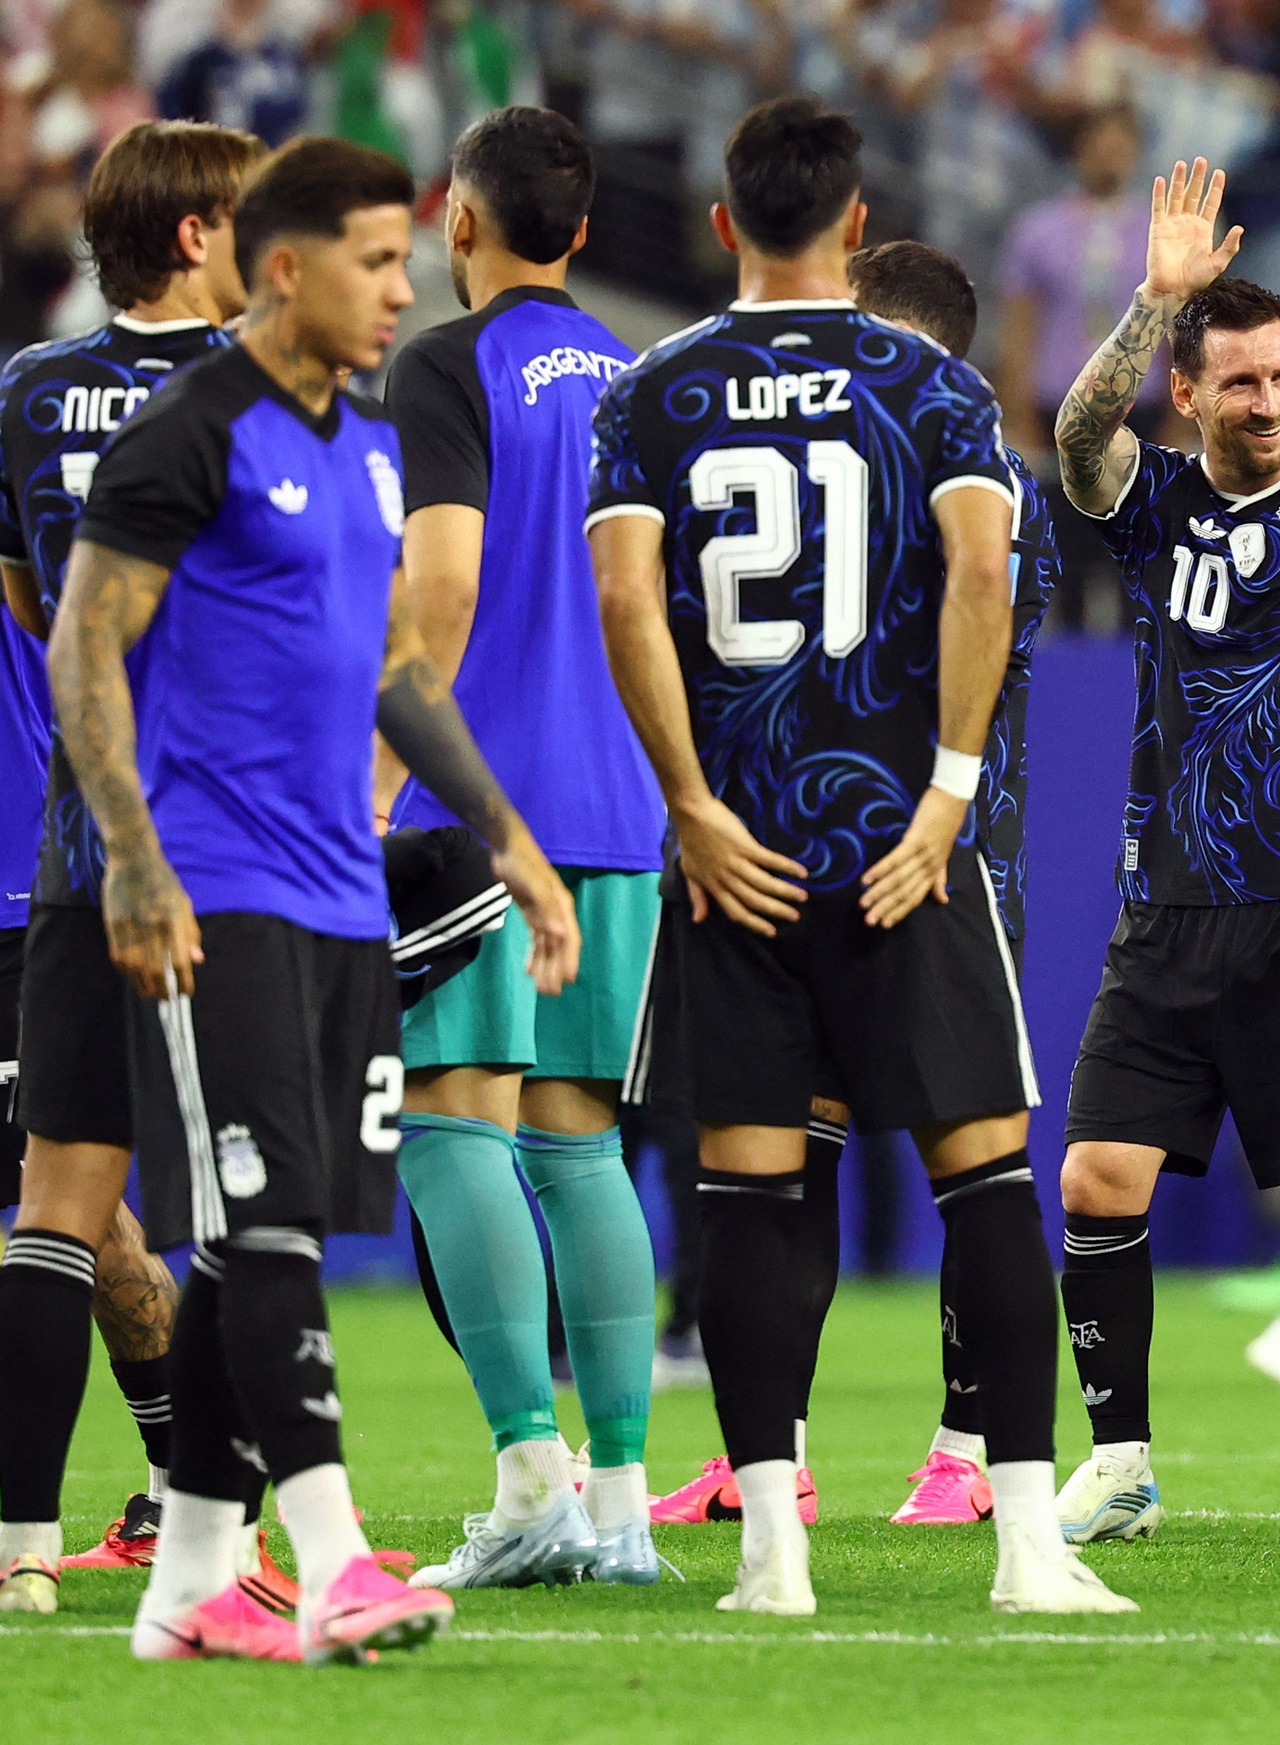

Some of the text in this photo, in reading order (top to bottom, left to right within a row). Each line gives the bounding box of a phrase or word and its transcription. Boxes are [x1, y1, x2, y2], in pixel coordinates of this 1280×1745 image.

[521, 346, 631, 406] ARGENT
[725, 368, 853, 421] LOPEZ
[688, 439, 870, 667] 21
[1169, 544, 1230, 634] 10
